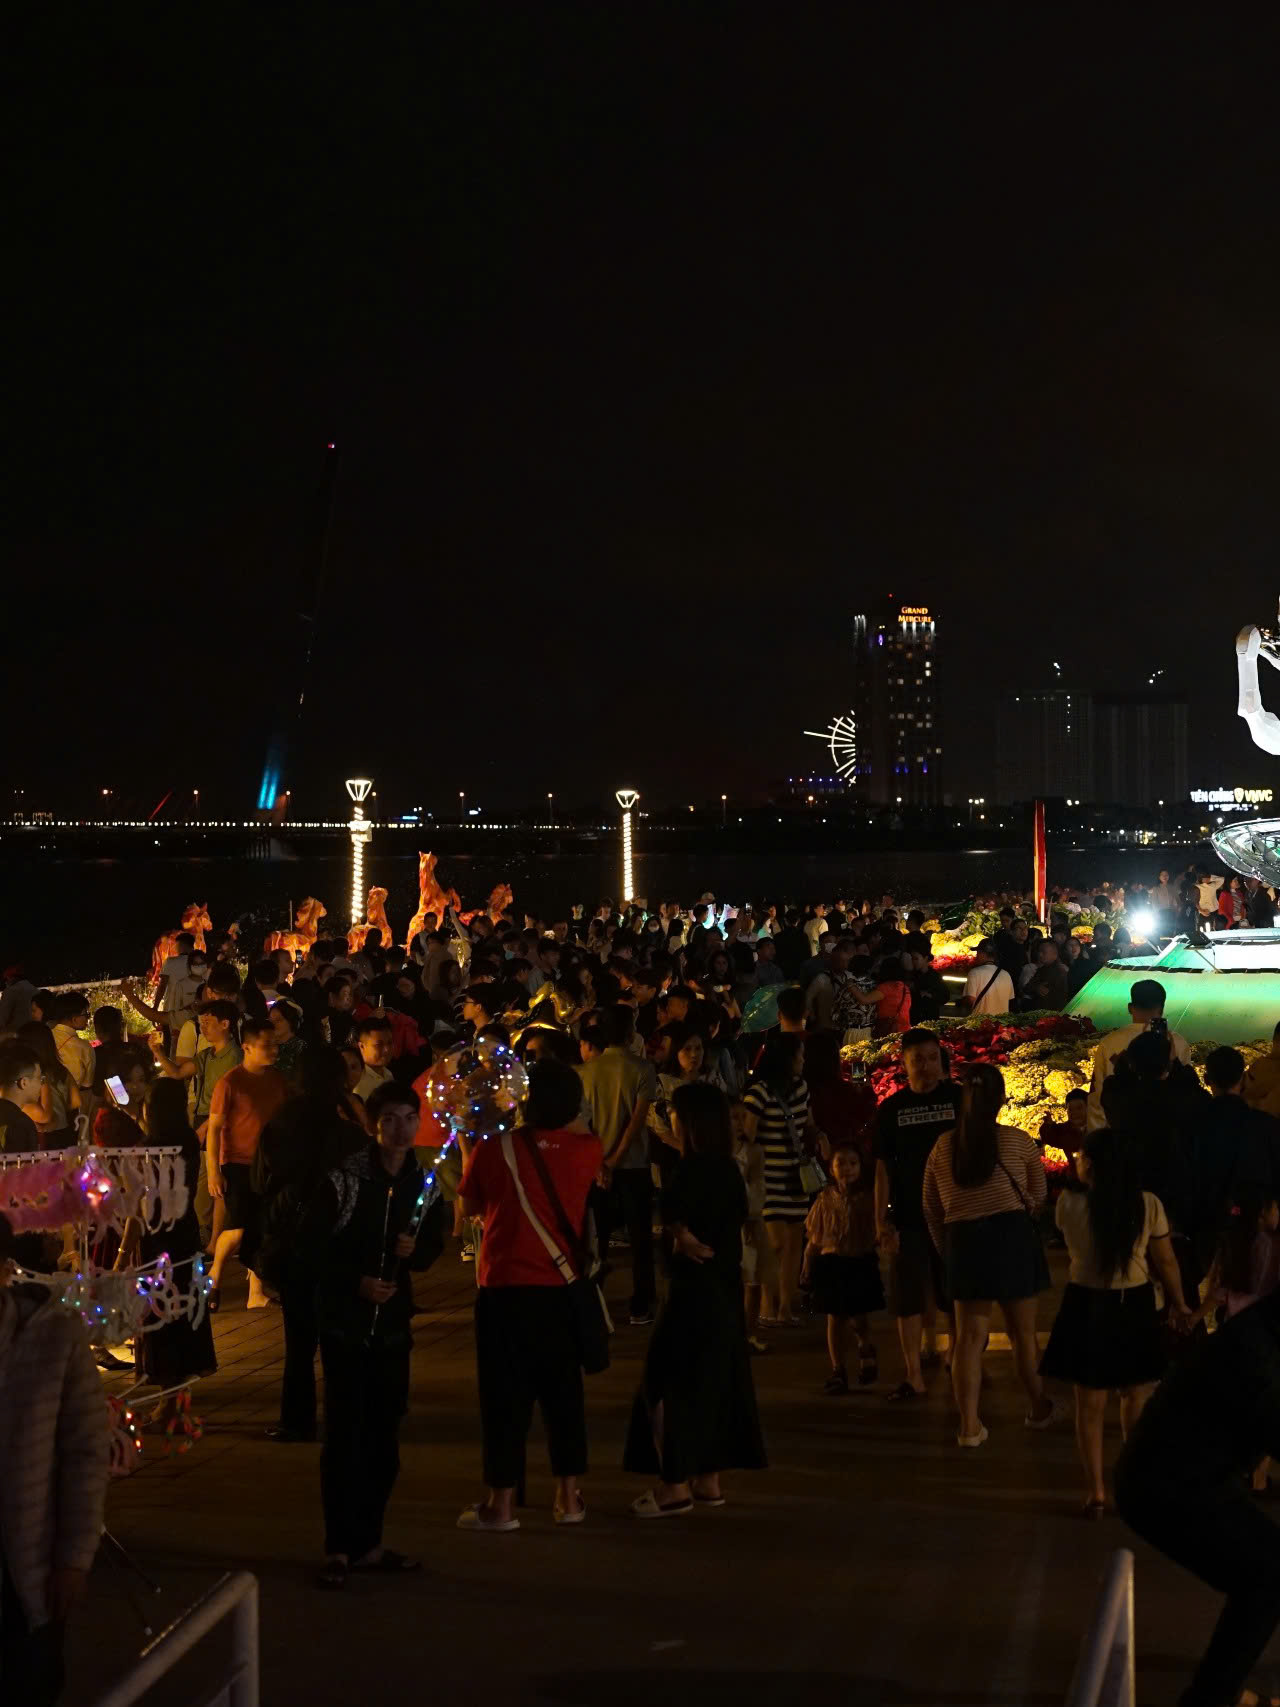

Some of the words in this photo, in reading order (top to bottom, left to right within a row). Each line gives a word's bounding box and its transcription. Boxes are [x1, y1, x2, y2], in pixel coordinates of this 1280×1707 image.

[901, 606, 928, 615] GRAND
[1245, 789, 1273, 802] VNVC
[897, 1105, 929, 1116] FROM
[931, 1102, 954, 1111] THE
[899, 1110, 953, 1125] STREETS
